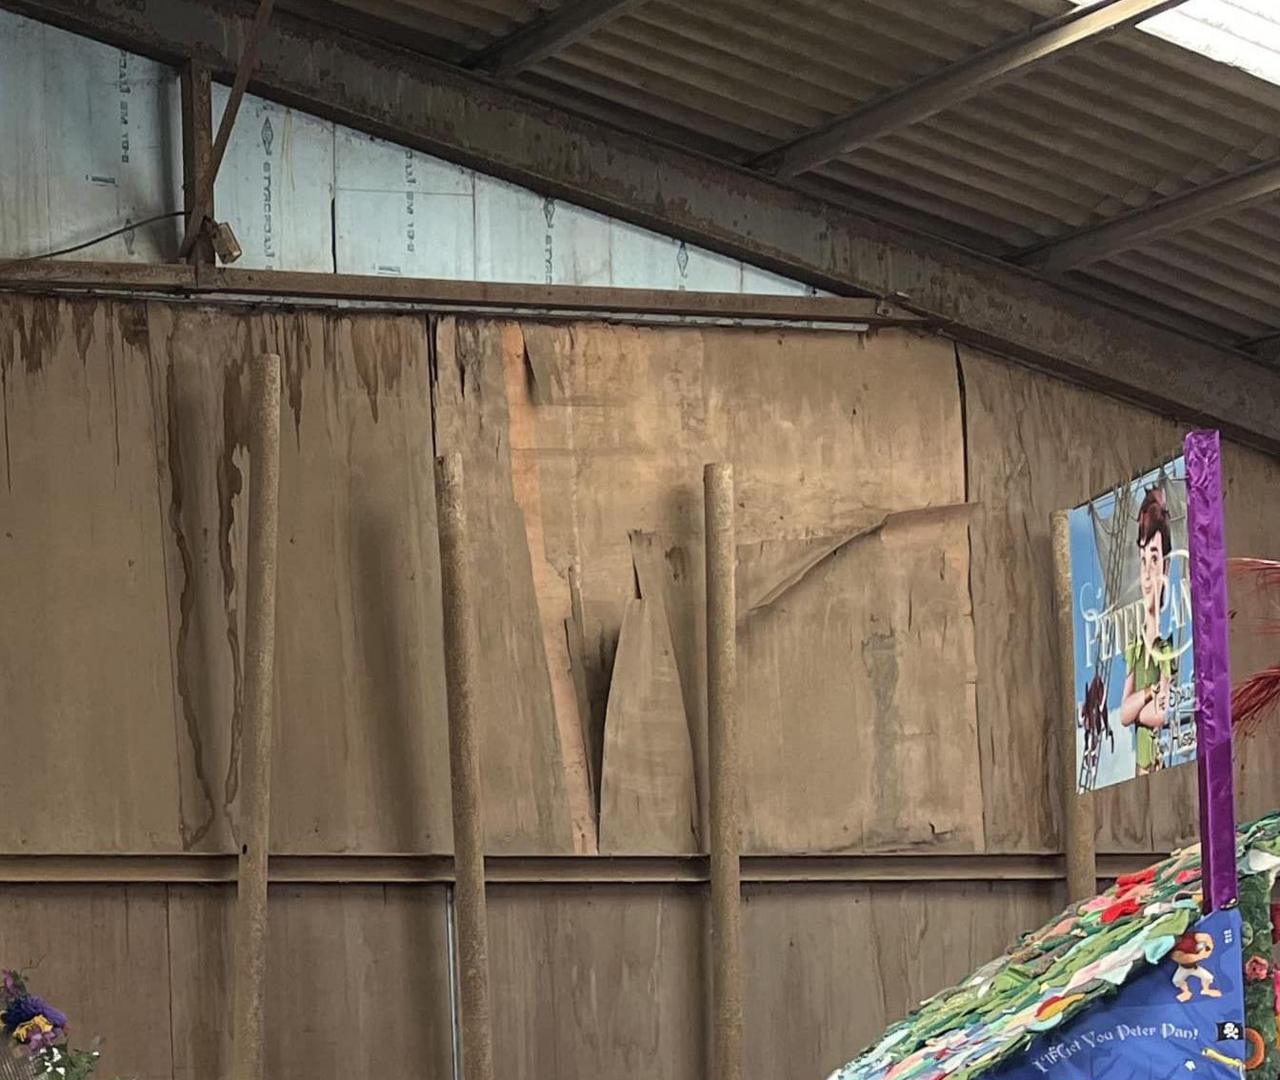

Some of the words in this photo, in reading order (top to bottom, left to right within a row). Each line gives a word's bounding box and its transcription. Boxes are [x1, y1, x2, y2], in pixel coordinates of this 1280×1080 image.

[1081, 585, 1149, 669] PETER
[1057, 1040, 1085, 1061] Get
[1082, 1030, 1114, 1049] You
[1117, 1023, 1157, 1042] Peter
[1160, 1022, 1200, 1041] Pan!
